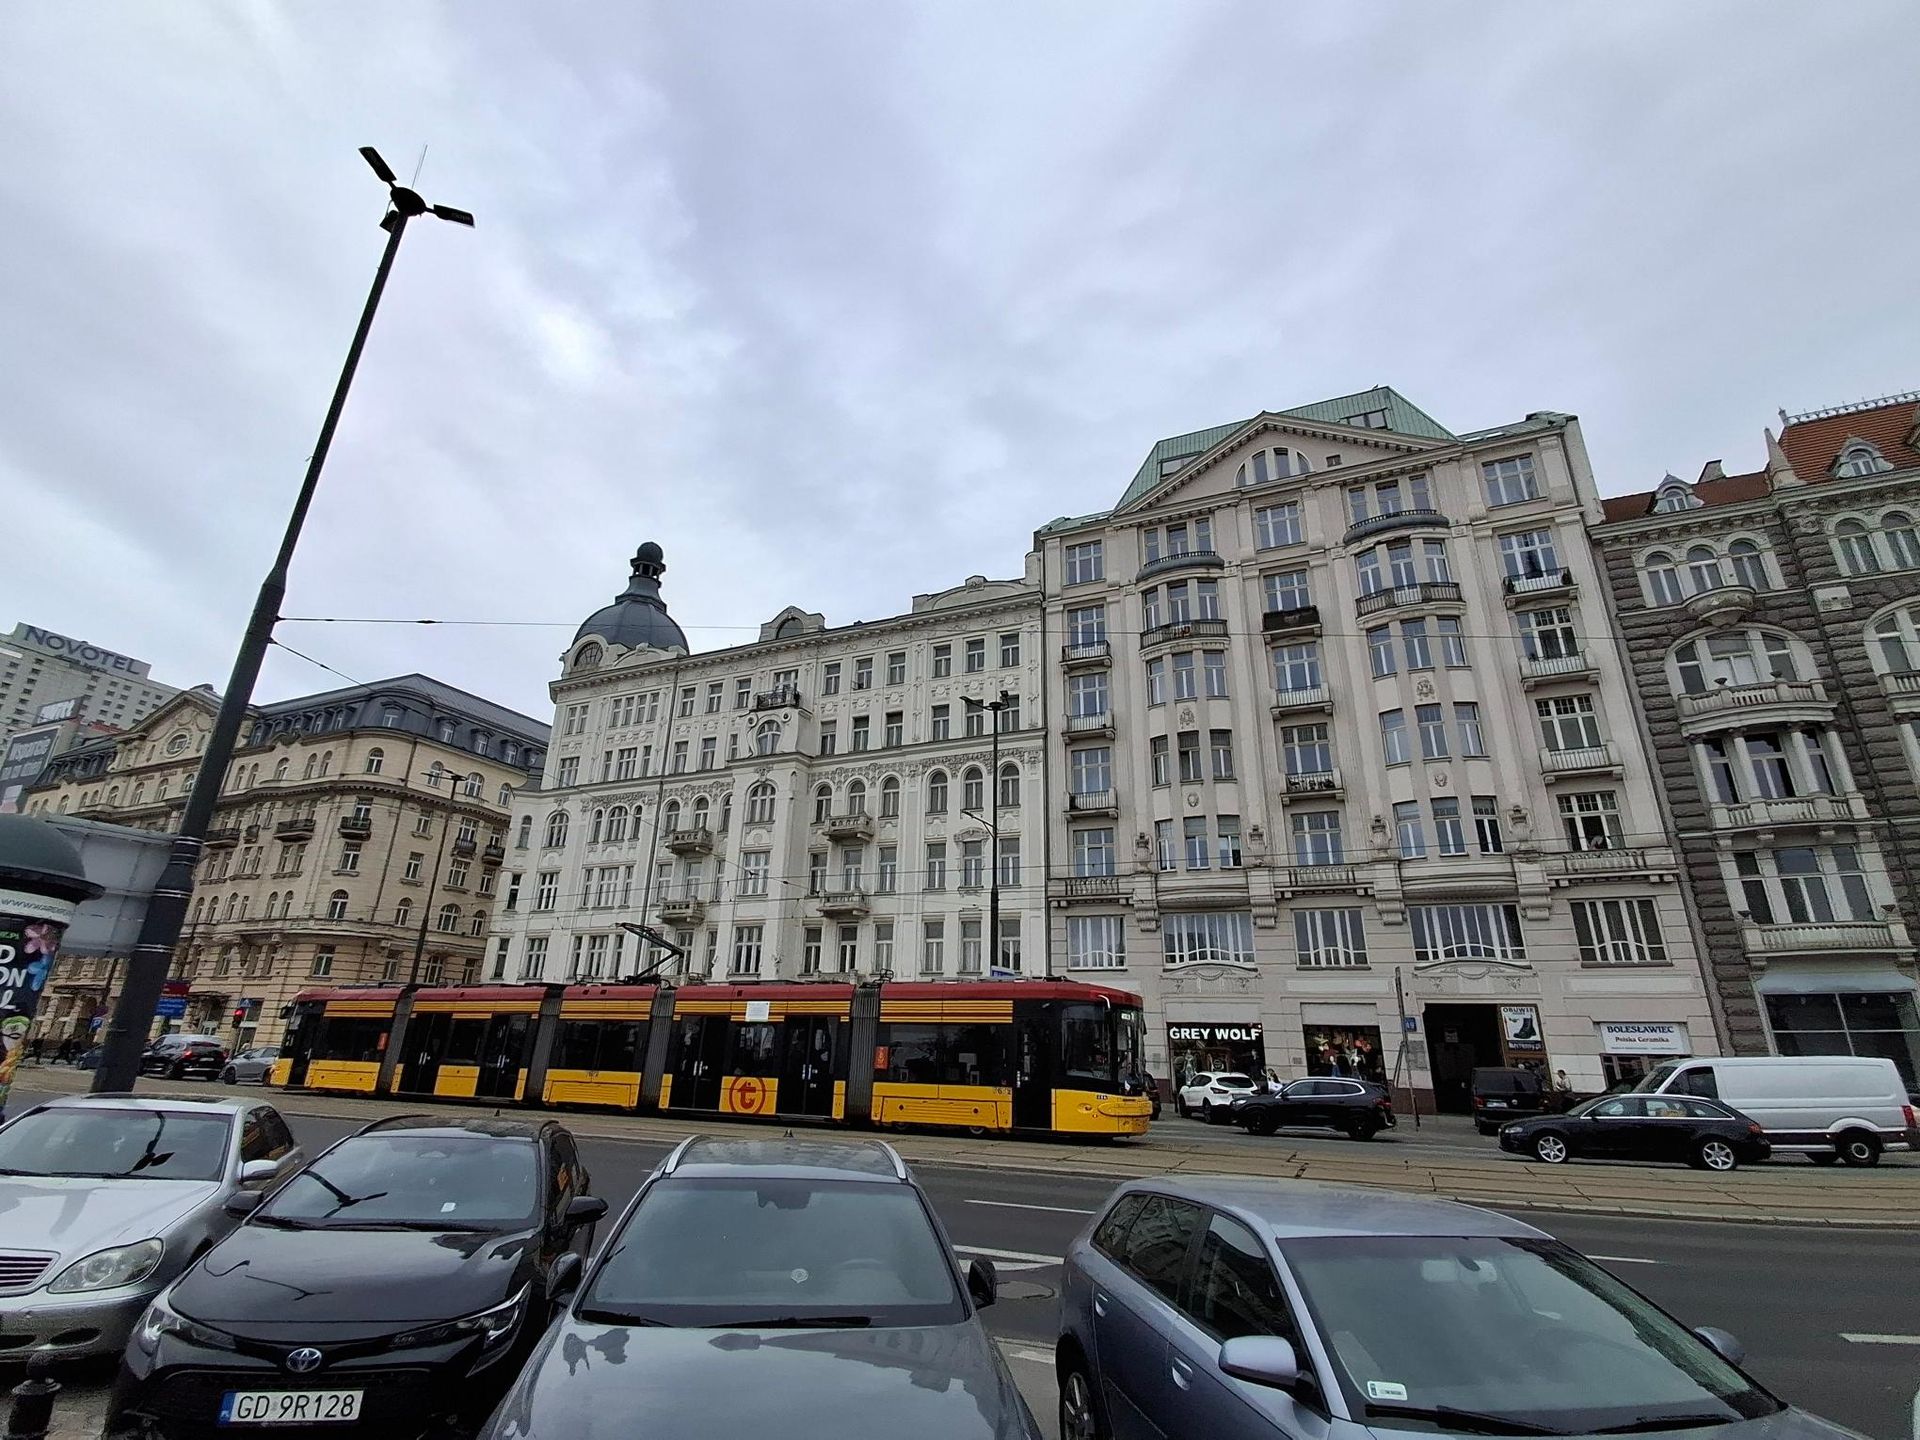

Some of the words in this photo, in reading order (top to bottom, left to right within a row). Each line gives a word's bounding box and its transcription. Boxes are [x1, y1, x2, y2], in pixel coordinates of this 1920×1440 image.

[24, 625, 140, 675] NOVOTEL
[1169, 1027, 1210, 1040] GREY
[1214, 1028, 1261, 1041] WOLF
[1606, 1025, 1674, 1034] BOLESŁAWIEC
[237, 1395, 270, 1419] GD
[278, 1394, 355, 1419] 9R128
